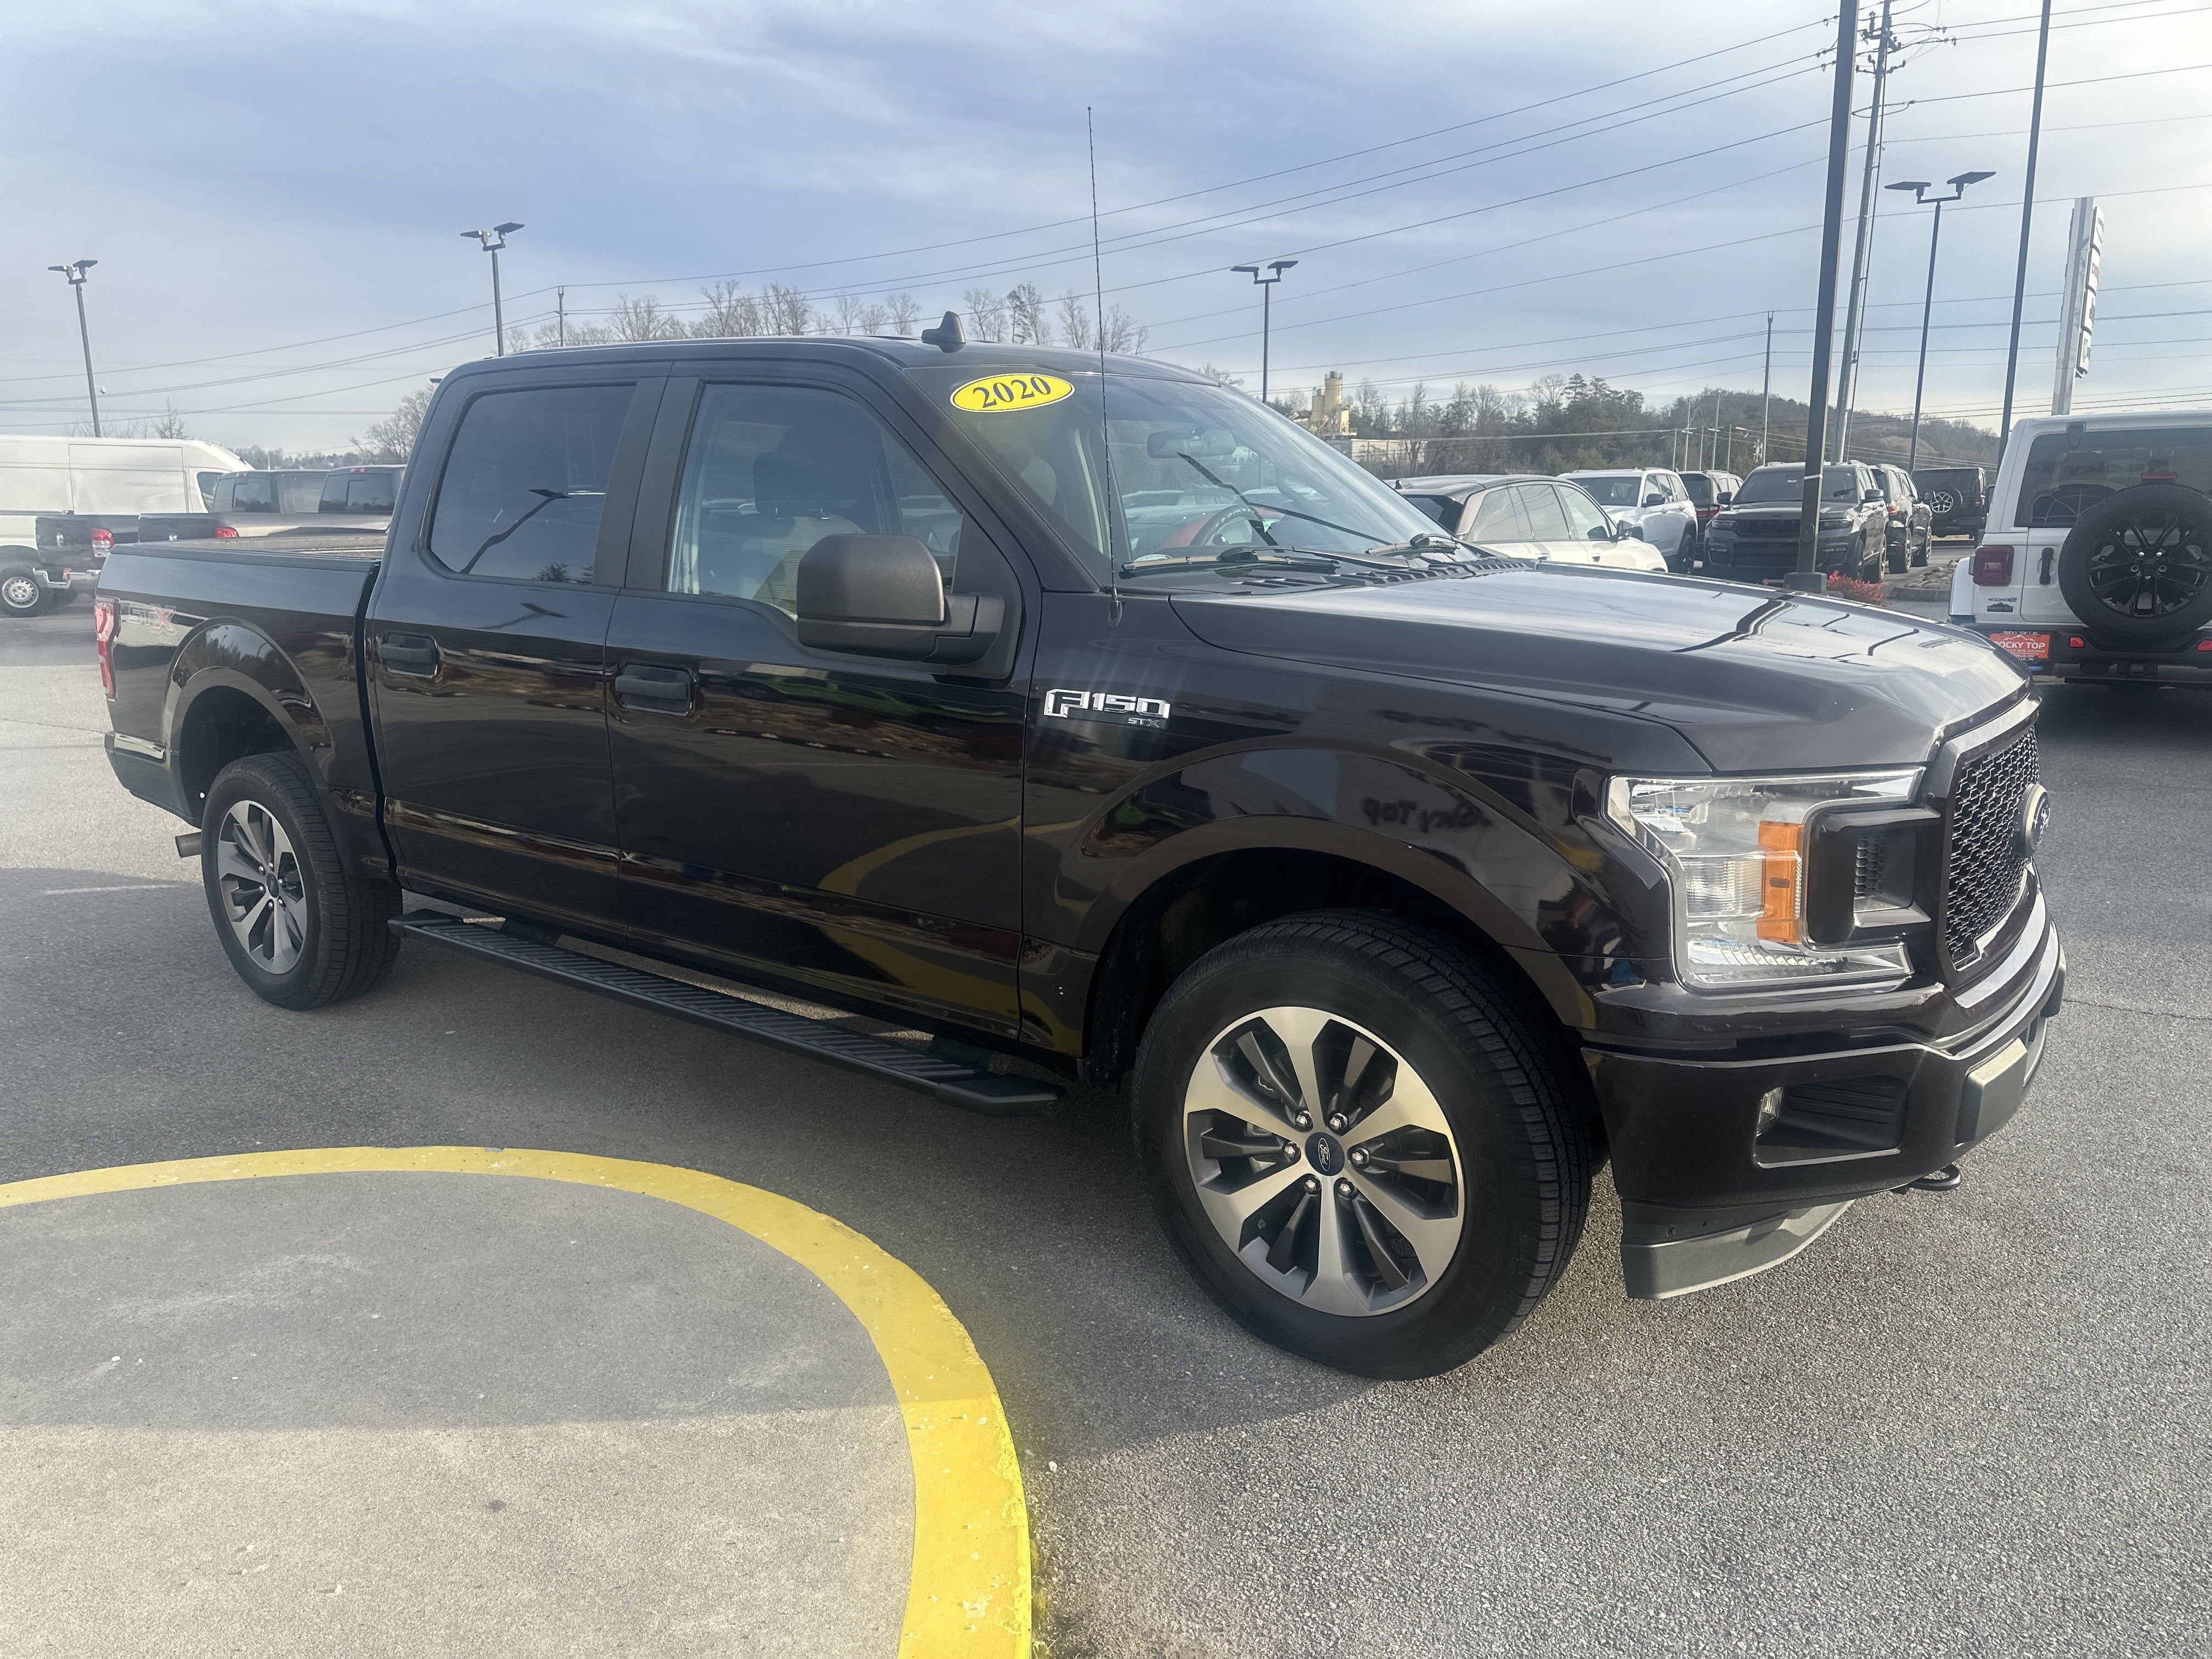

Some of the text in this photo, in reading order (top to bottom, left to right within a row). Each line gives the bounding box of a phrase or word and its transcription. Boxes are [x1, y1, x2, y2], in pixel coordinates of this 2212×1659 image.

[973, 376, 1051, 408] 2020
[127, 605, 176, 633] STX
[1127, 717, 1160, 729] STX
[1319, 1144, 1329, 1165] Ford
